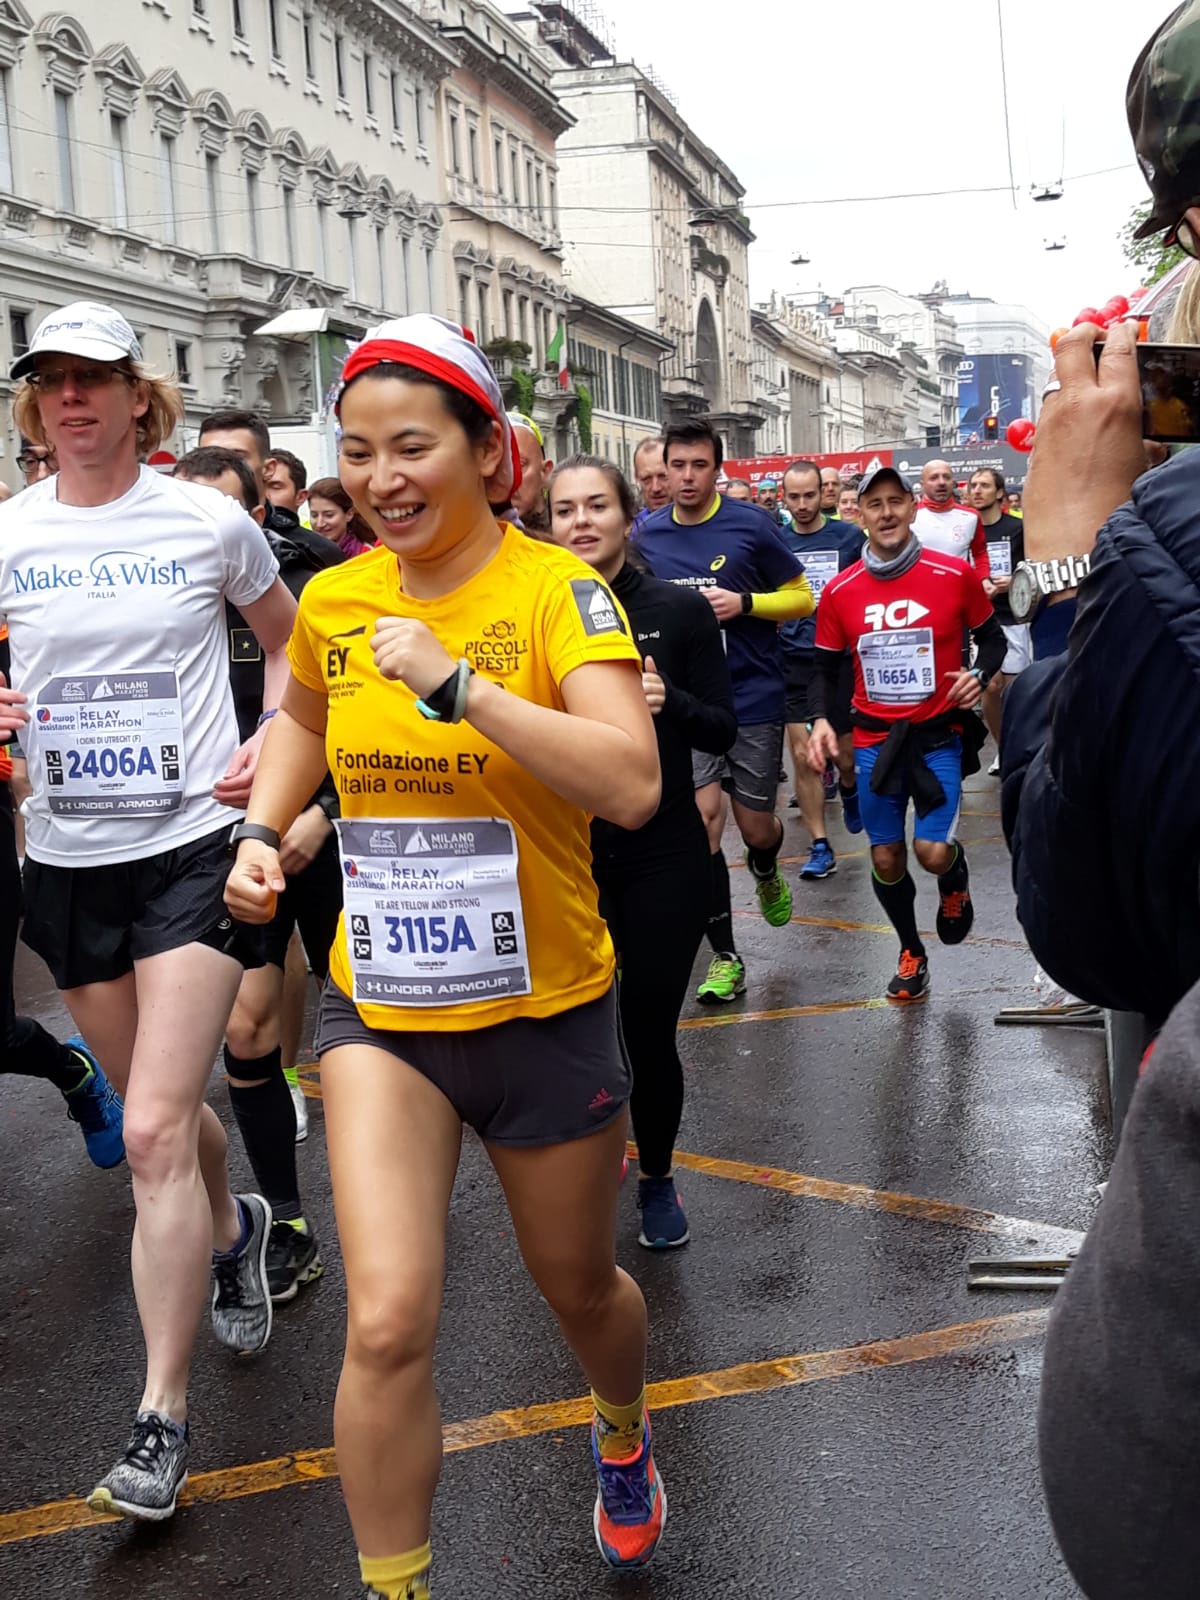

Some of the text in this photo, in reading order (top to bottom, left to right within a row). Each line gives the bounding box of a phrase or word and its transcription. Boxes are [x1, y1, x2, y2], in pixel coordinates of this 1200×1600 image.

[87, 591, 117, 599] ITALIA
[328, 647, 349, 678] EY
[475, 656, 519, 671] PESTI
[877, 668, 918, 685] 1665A
[114, 680, 149, 690] MILANO
[52, 714, 75, 724] europ
[80, 709, 121, 721] RELAY
[38, 722, 76, 731] assistance
[80, 718, 142, 730] MARATHON
[104, 735, 131, 744] UTRECHT
[66, 746, 157, 779] 2406A
[336, 748, 490, 775] Fondazione EY
[340, 773, 455, 795] Italia onlus
[73, 798, 172, 810] UNDER ARMOUR
[430, 832, 475, 843] MILANO
[360, 871, 386, 881] europ
[392, 868, 440, 880] RELAY
[346, 879, 386, 890] assistance
[391, 879, 465, 890] MARATHON
[386, 900, 400, 910] ARE
[400, 900, 430, 911] YELLOW
[431, 899, 448, 910] AND
[449, 897, 481, 909] STRONG
[384, 914, 477, 954] 3115A
[384, 978, 510, 995] UNDER ARMOUR
